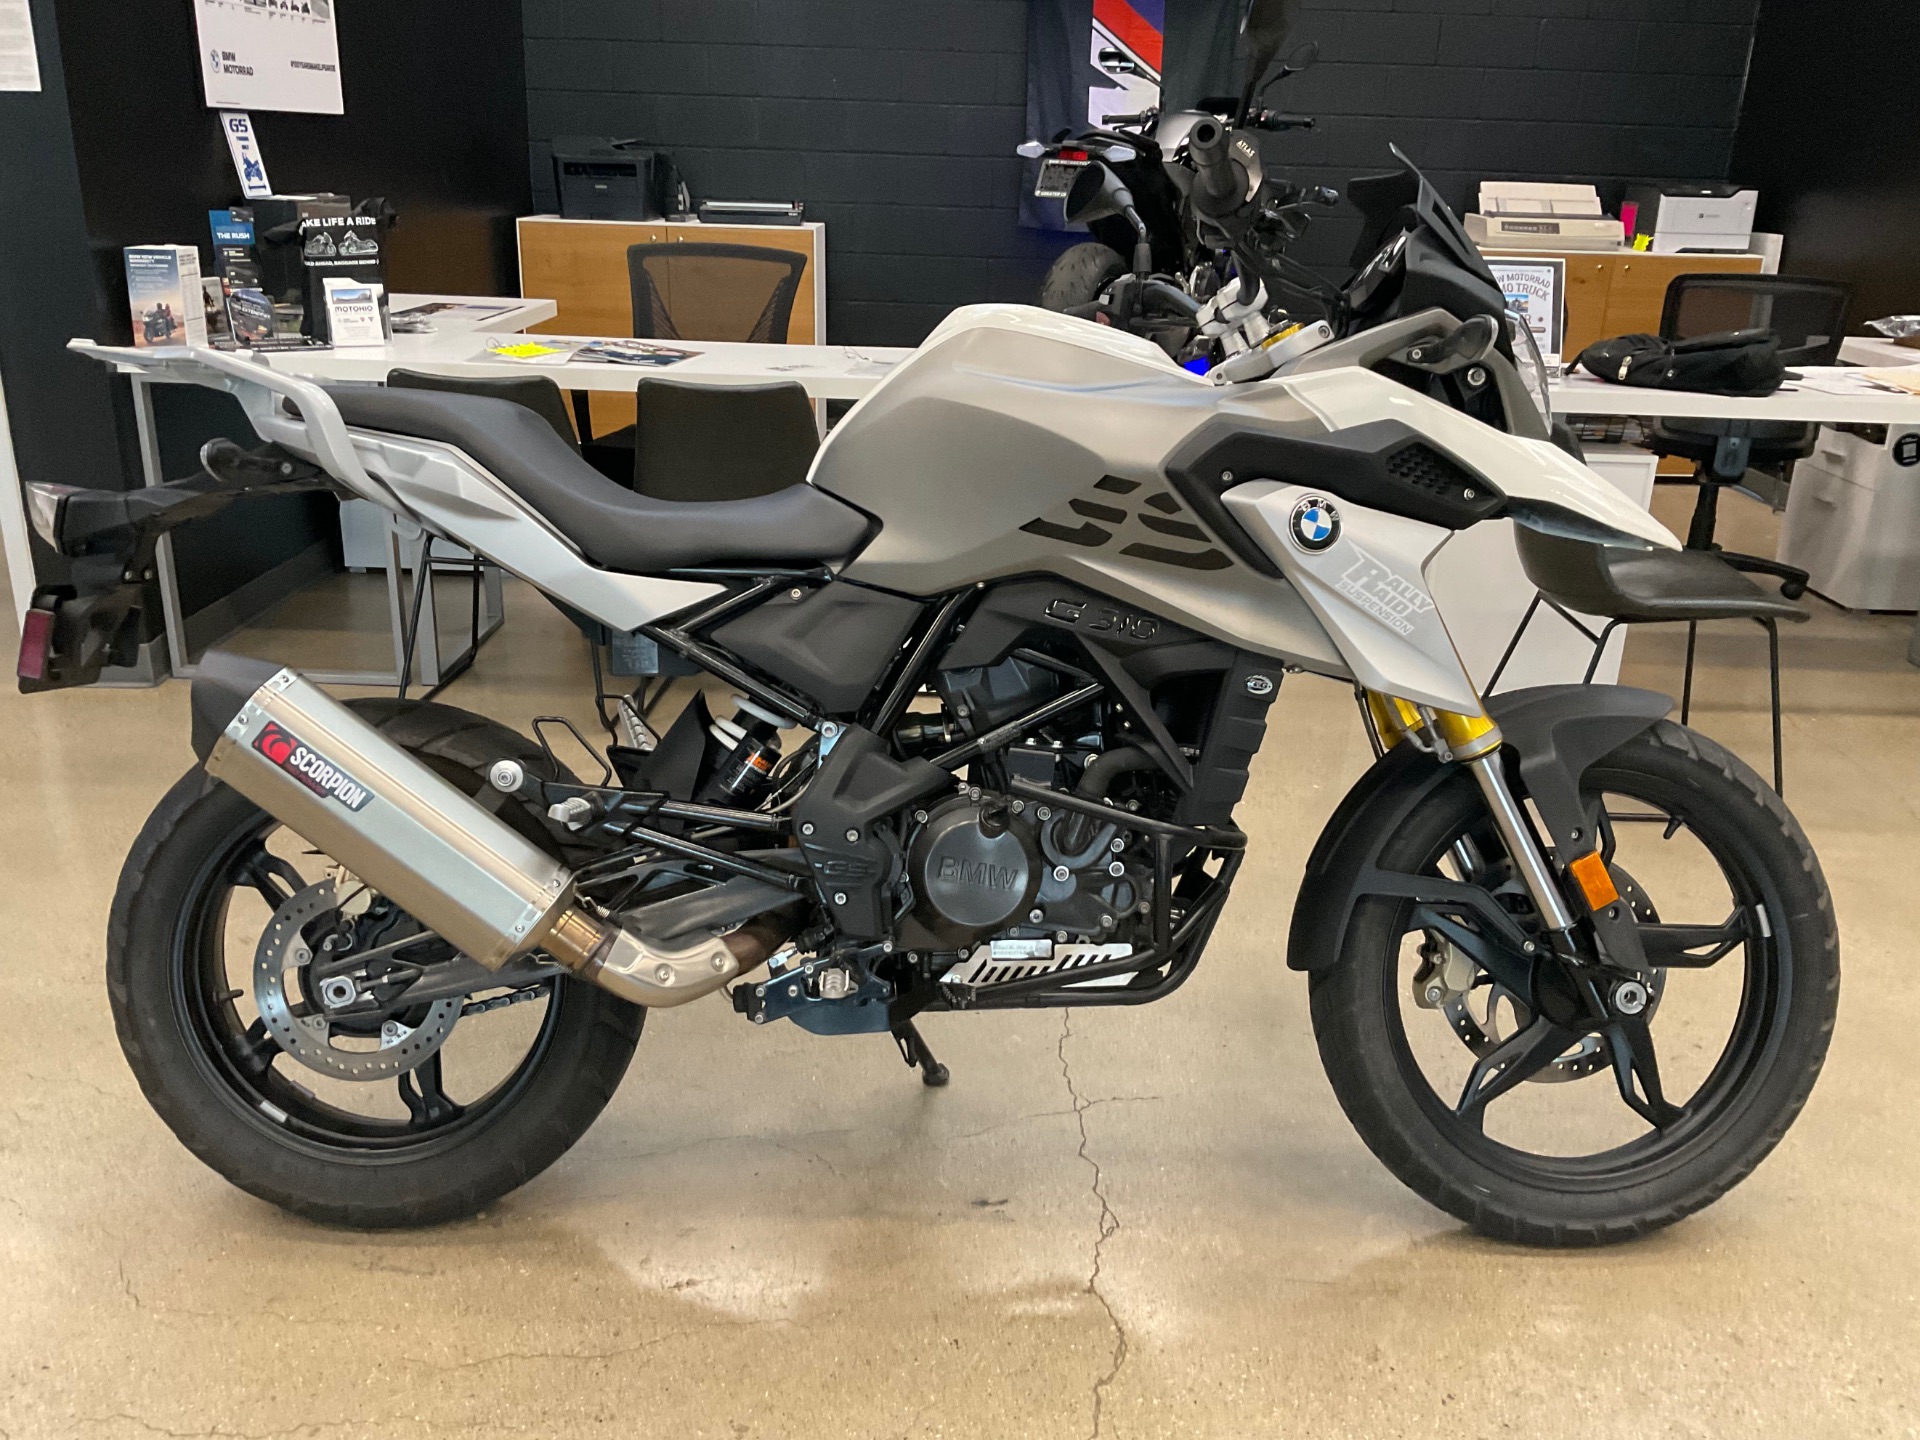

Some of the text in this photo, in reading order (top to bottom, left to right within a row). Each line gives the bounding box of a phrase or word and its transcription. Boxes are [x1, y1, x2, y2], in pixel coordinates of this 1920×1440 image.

[222, 51, 236, 62] BMW
[223, 64, 254, 76] MOTORRAD
[229, 118, 248, 133] GS
[1236, 140, 1255, 158] ATLAS
[322, 217, 345, 227] LIFE
[346, 216, 354, 226] A
[355, 216, 377, 226] RIDE
[217, 232, 250, 240] THE RUSH
[1507, 273, 1551, 289] MOTORRAD
[1516, 283, 1551, 301] TRUCK
[1300, 500, 1340, 522] BMW
[1335, 580, 1415, 636] SUSPENSION
[1044, 599, 1160, 640] G 310
[290, 746, 367, 809] SCORPION
[937, 855, 1018, 891] BMW
